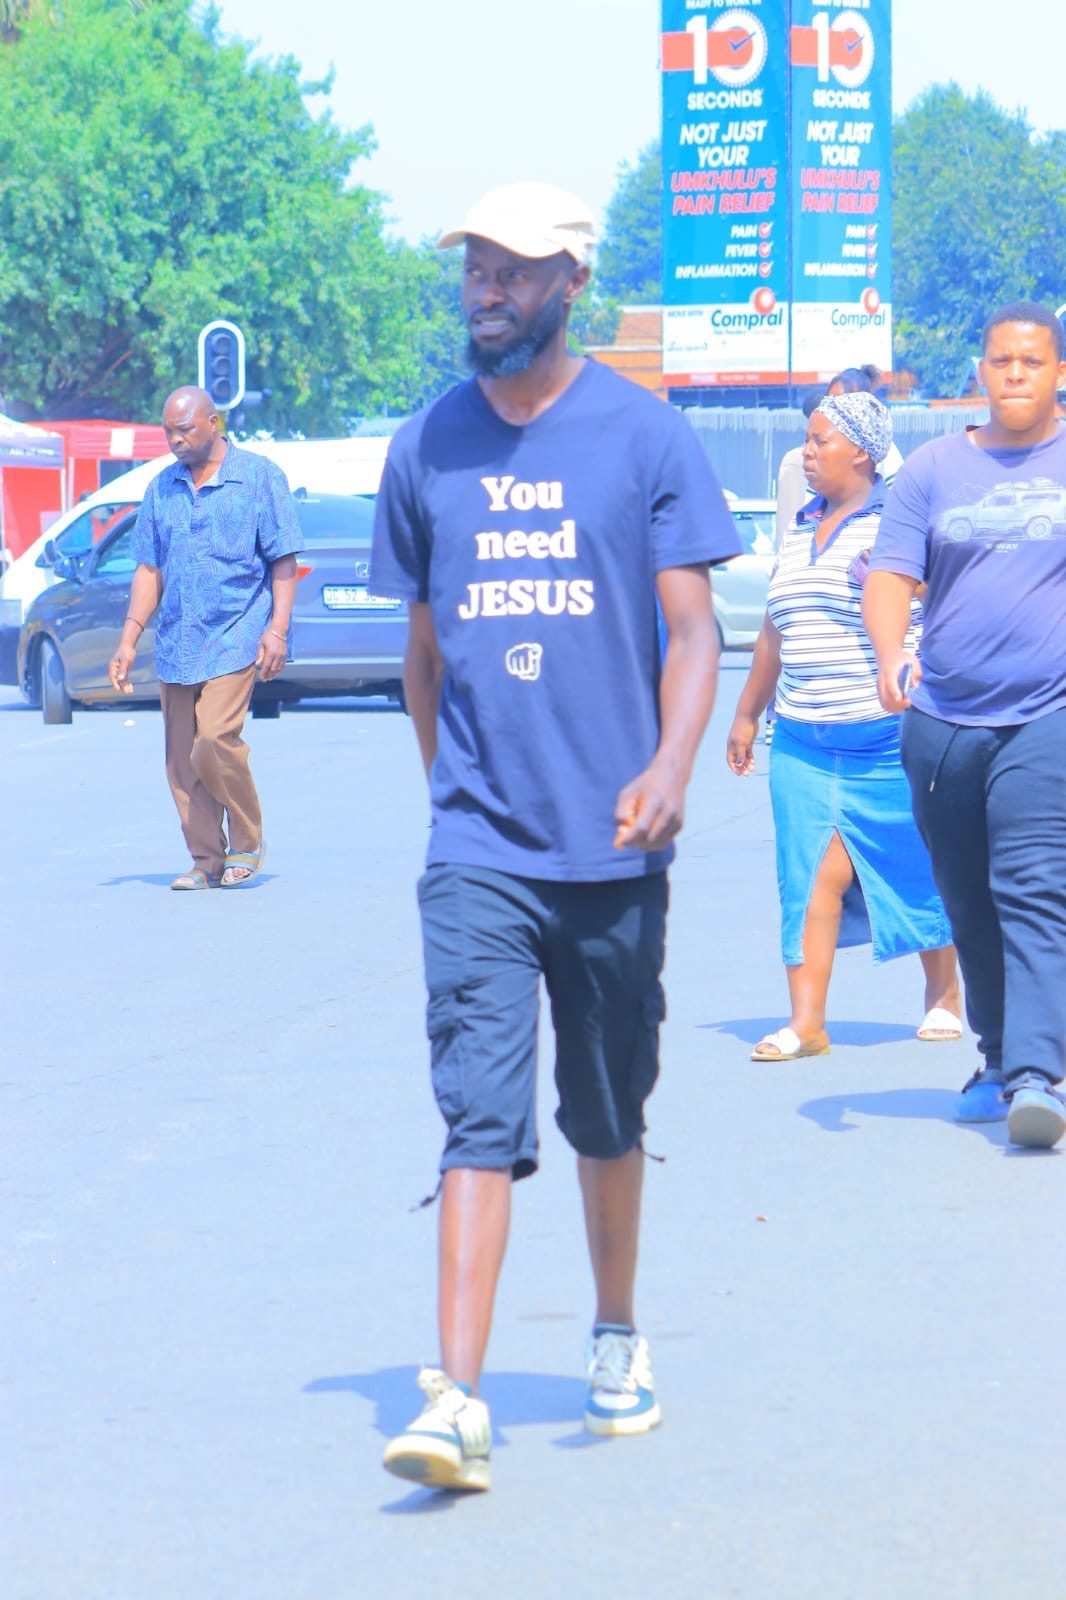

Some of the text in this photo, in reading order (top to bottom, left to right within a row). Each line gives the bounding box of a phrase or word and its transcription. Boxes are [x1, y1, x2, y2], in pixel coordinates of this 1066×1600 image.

[686, 10, 767, 88] 10
[812, 9, 875, 88] 10
[687, 89, 764, 110] SECONDS
[680, 120, 767, 145] NOT JUST
[807, 120, 874, 144] NOT JUST
[697, 145, 749, 168] YOUR
[821, 144, 860, 167] YOUR
[671, 167, 778, 193] UMKHULU'S
[672, 191, 776, 216] PAIN RELIEF
[801, 192, 880, 214] PAIN RELIEF
[730, 224, 758, 238] PAIN
[725, 243, 758, 258] FEVER
[675, 263, 758, 279] INFLAMMATION
[711, 307, 783, 330] Compral
[831, 309, 886, 328] Compral
[481, 476, 564, 511] You
[475, 519, 577, 560] need
[458, 579, 594, 620] JESUS
